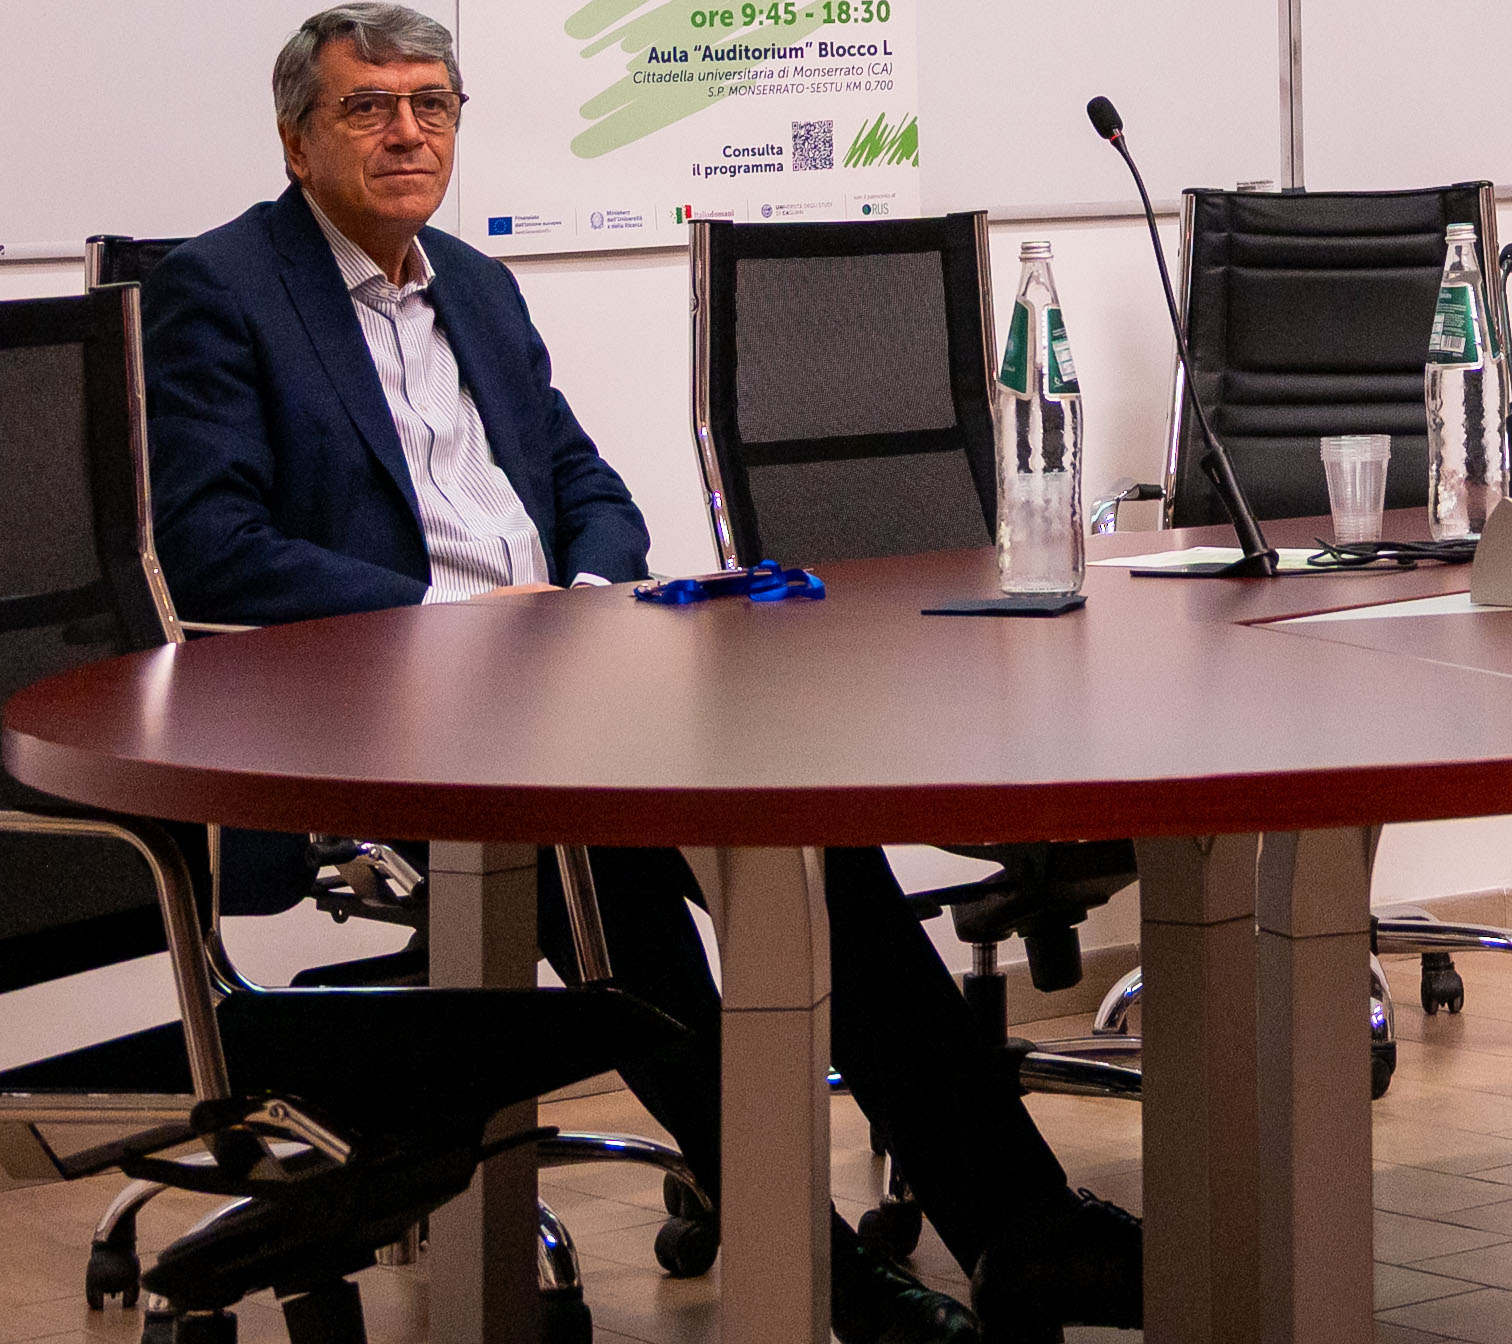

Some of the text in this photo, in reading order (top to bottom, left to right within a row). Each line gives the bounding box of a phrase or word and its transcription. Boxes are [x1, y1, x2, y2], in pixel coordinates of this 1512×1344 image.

[690, 6, 734, 29] ore
[741, 1, 797, 27] 9:45
[822, 0, 892, 24] 18:30
[647, 46, 689, 64] Aula
[817, 40, 878, 58] Blocco
[882, 40, 893, 57] L
[633, 62, 893, 85] Cittadella universitaria di Monserrato (CA)
[707, 79, 893, 97] S.P. MONSERRATO-SESTU KM 0,700
[722, 144, 784, 159] Consulta
[692, 162, 785, 179] il programma
[872, 203, 889, 215] RUS
